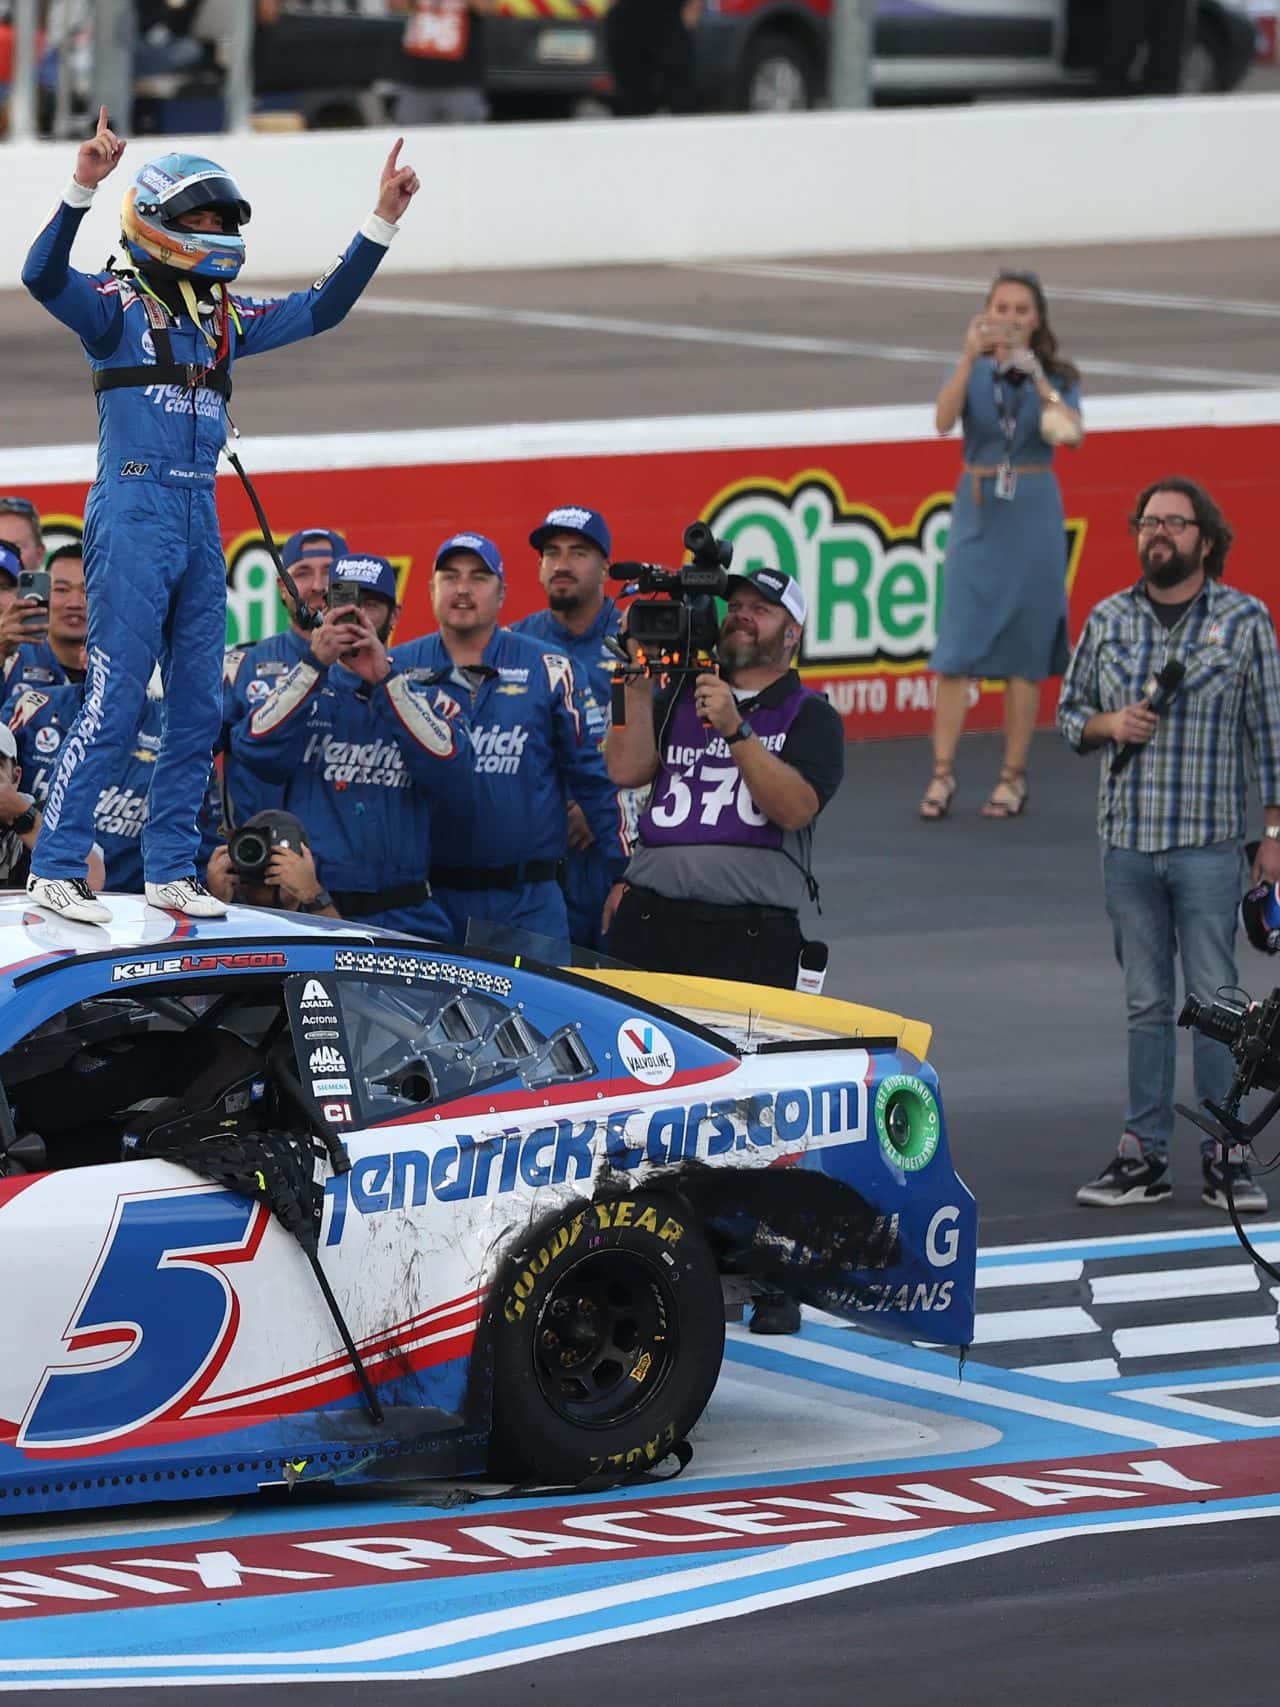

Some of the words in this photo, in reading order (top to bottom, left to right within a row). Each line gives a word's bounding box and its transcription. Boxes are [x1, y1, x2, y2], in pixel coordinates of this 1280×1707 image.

[299, 1000, 334, 1009] AXALTA
[302, 1015, 338, 1025] Acronis
[309, 1046, 346, 1067] MAC
[626, 1052, 672, 1073] VALVOLINE
[310, 1064, 347, 1074] TOOLS
[316, 1082, 349, 1091] SIEMENS
[323, 1104, 352, 1122] CI
[17, 1187, 265, 1447] 5
[315, 1460, 1223, 1572] RACEWAY
